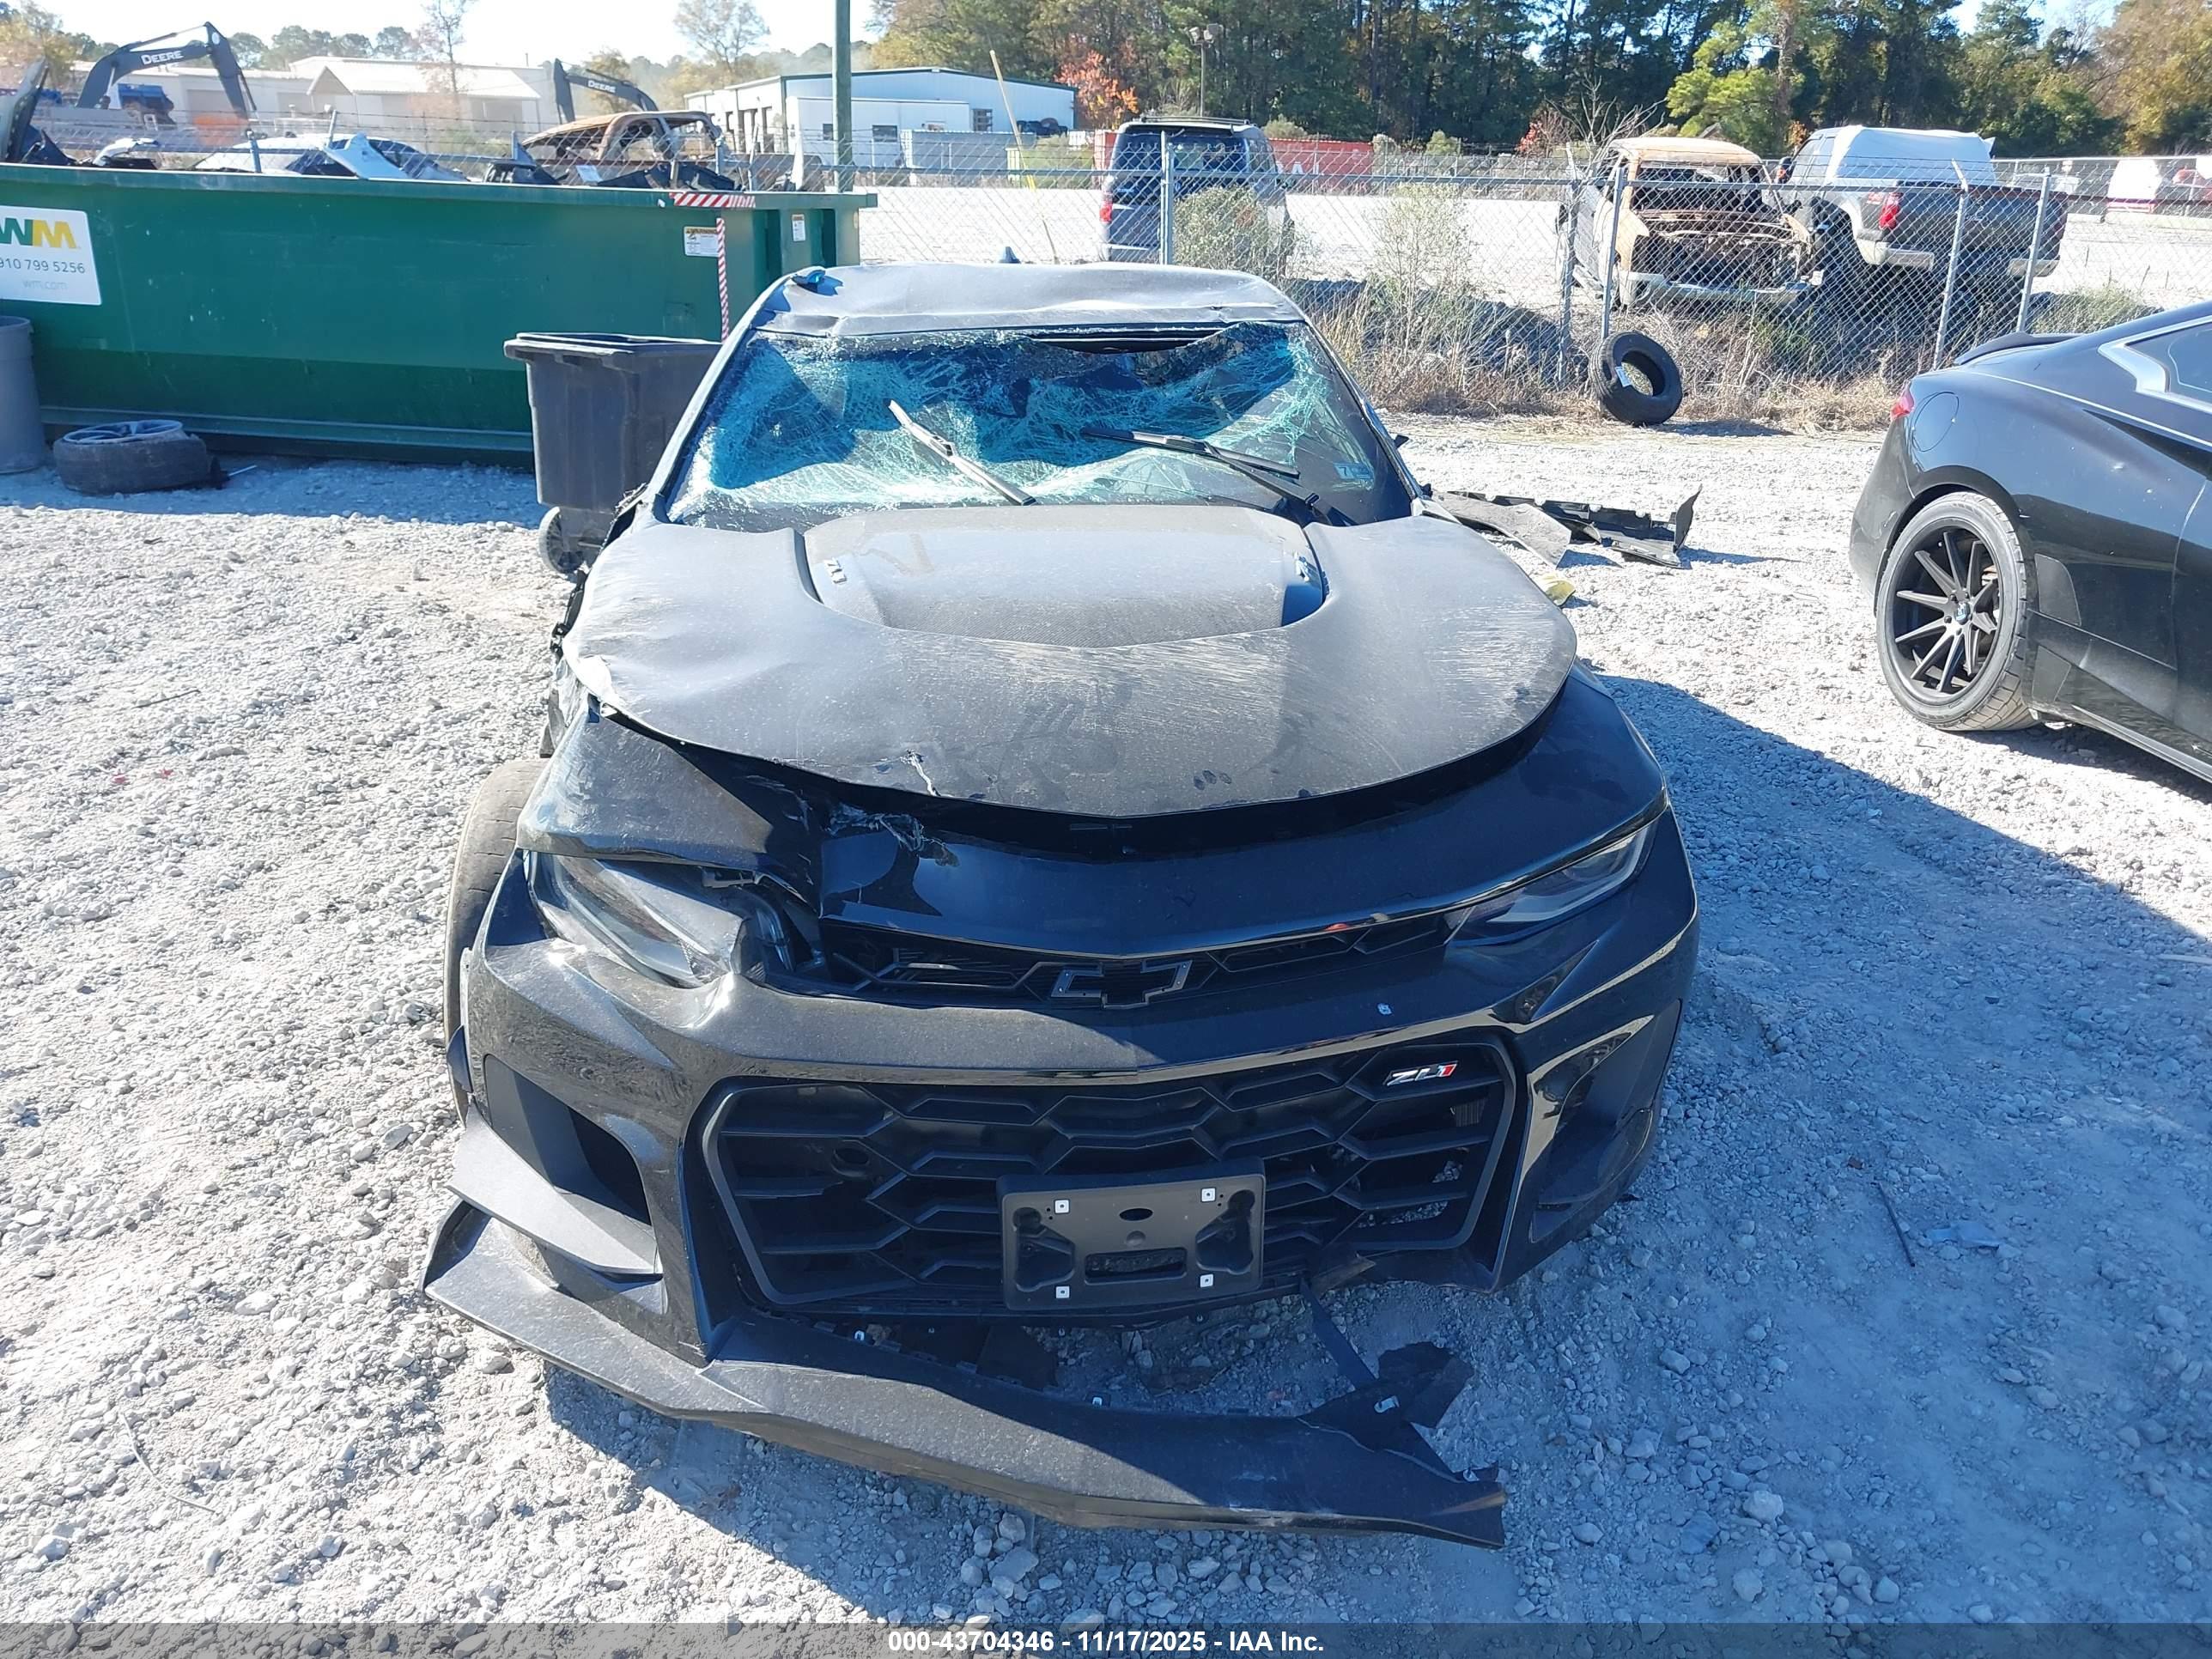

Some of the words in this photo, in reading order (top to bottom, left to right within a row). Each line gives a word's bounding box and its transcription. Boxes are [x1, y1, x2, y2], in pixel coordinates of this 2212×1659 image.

[141, 50, 184, 65] DEERE
[587, 80, 617, 94] DEERE
[24, 258, 49, 271] 799
[52, 261, 86, 274] 5256
[1387, 1064, 1457, 1086] ZL1
